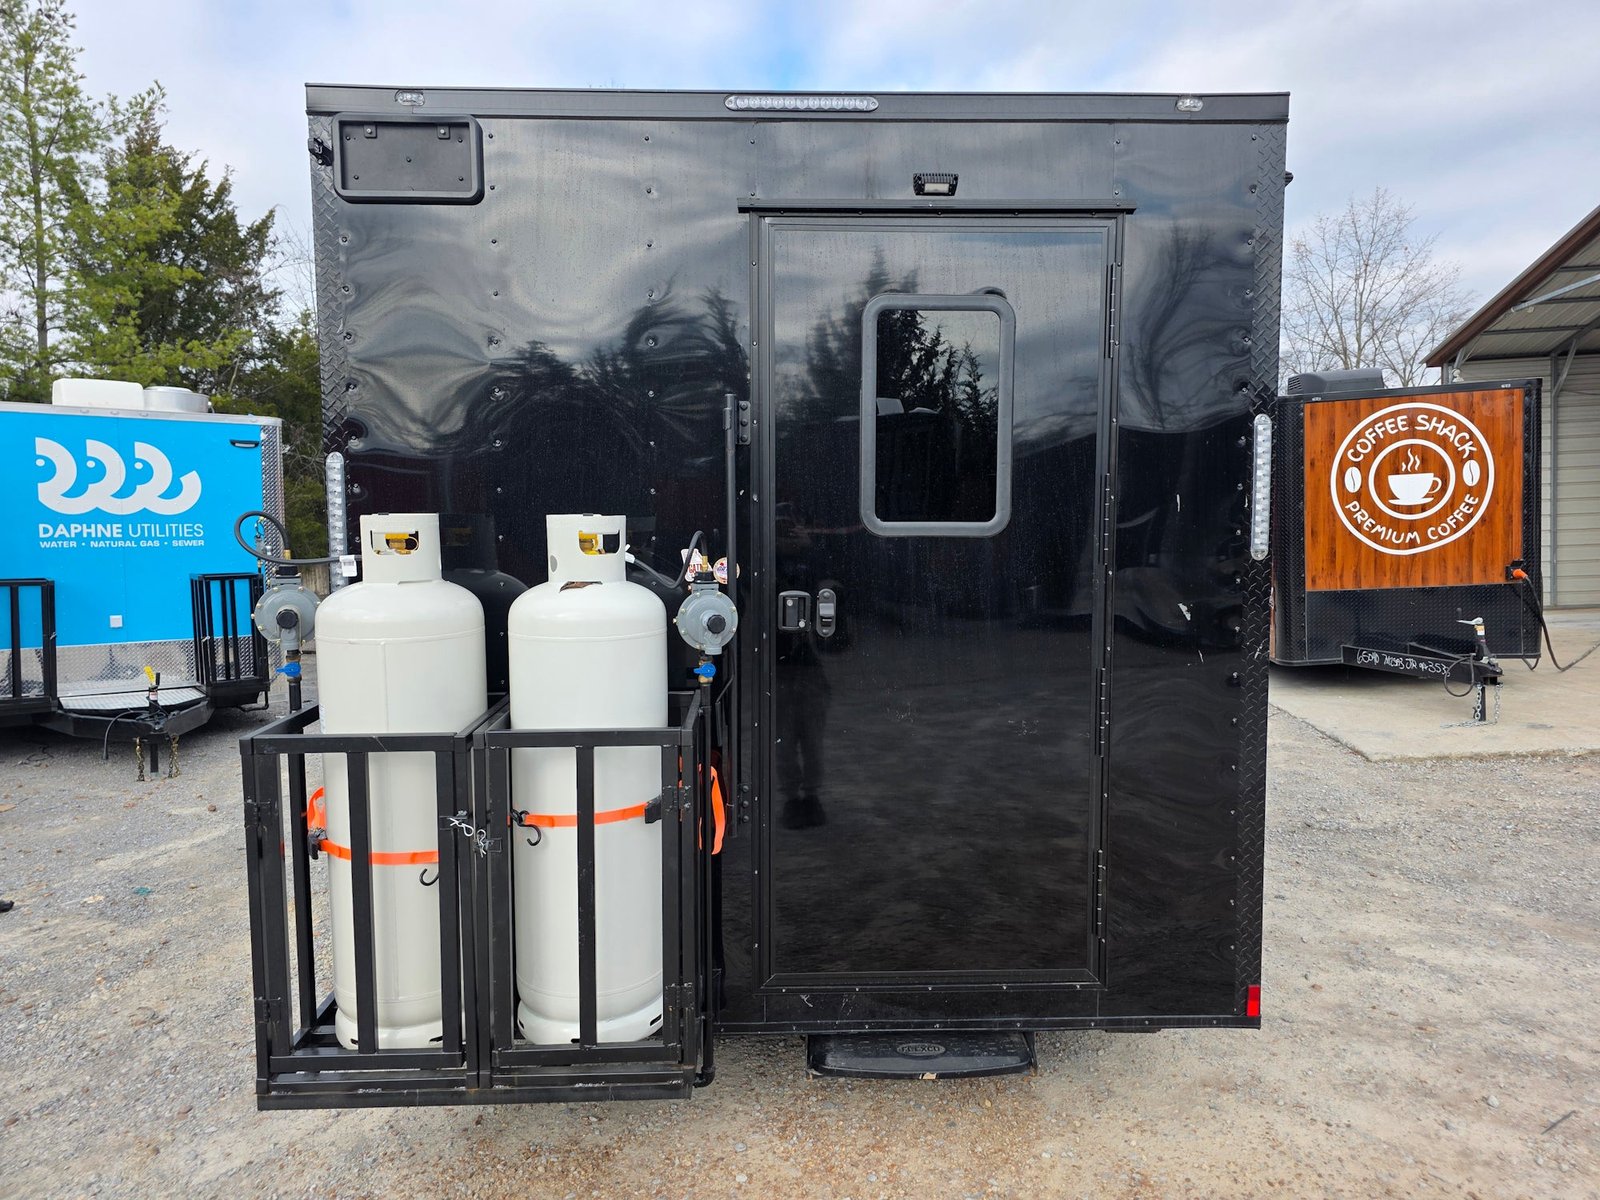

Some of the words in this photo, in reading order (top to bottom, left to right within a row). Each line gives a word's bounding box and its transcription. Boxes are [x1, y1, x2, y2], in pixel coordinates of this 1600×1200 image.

[1347, 415, 1409, 462] COFFEE
[1414, 414, 1478, 459] SHACK
[38, 523, 123, 538] DAPHNE
[128, 523, 204, 538] UTILITIES
[1345, 500, 1421, 545] PREMIUM
[1427, 493, 1479, 540] COFFEE
[39, 540, 77, 548] WATER
[90, 540, 137, 548] NATURAL
[139, 539, 160, 547] GAS
[171, 539, 205, 547] SEWER
